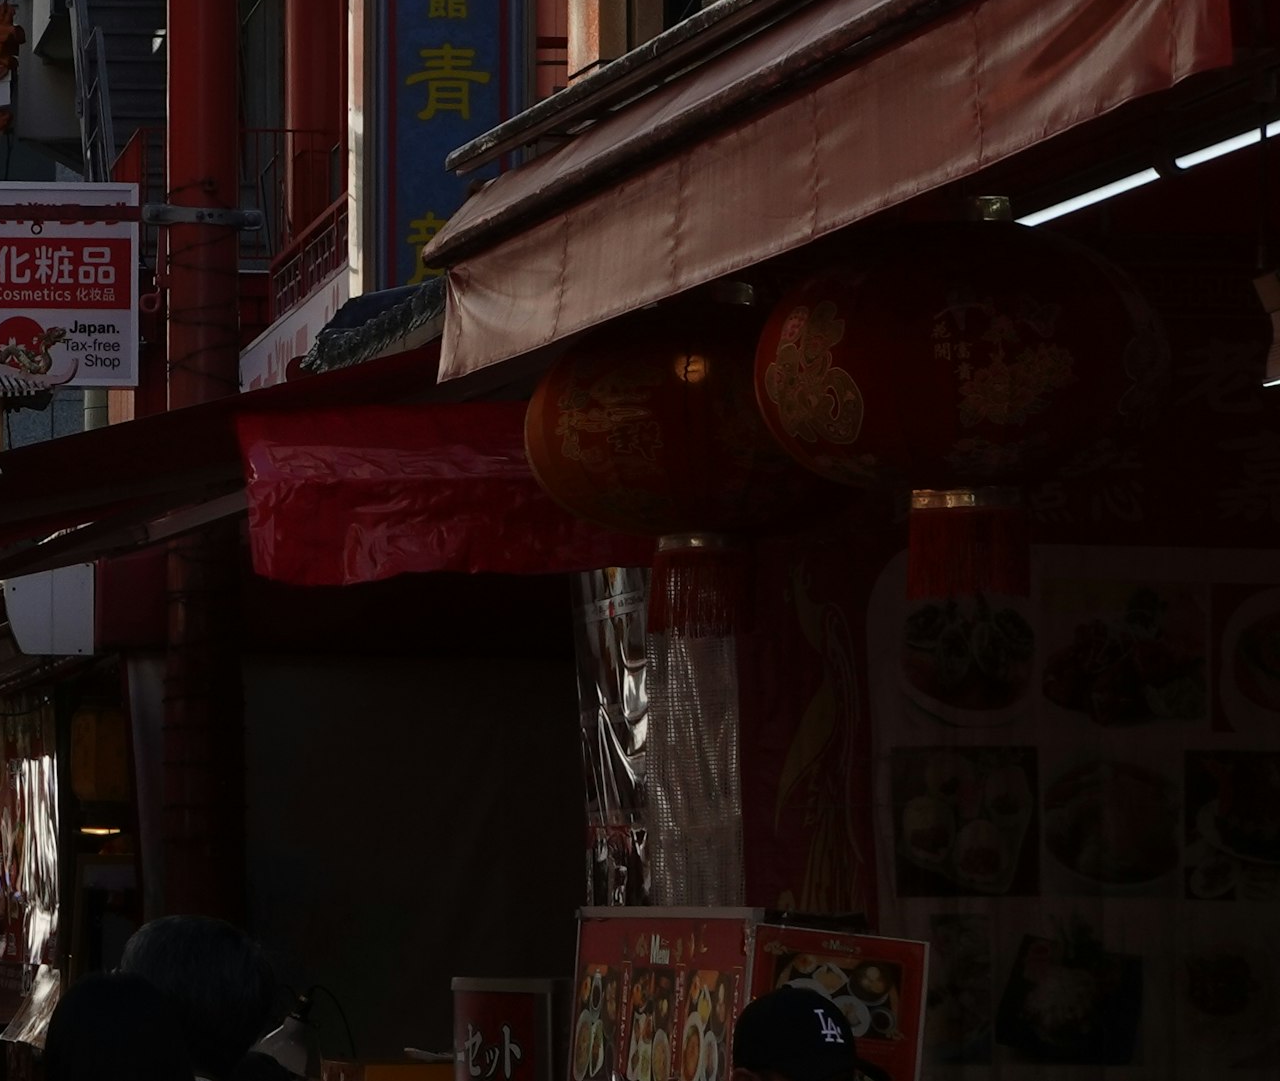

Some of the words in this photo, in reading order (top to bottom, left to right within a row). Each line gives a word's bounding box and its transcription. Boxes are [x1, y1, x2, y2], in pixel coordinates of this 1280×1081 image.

[64, 338, 122, 352] Tax-free
[83, 354, 122, 370] Shop
[813, 1008, 845, 1043] LA
[464, 1022, 523, 1080] セット
